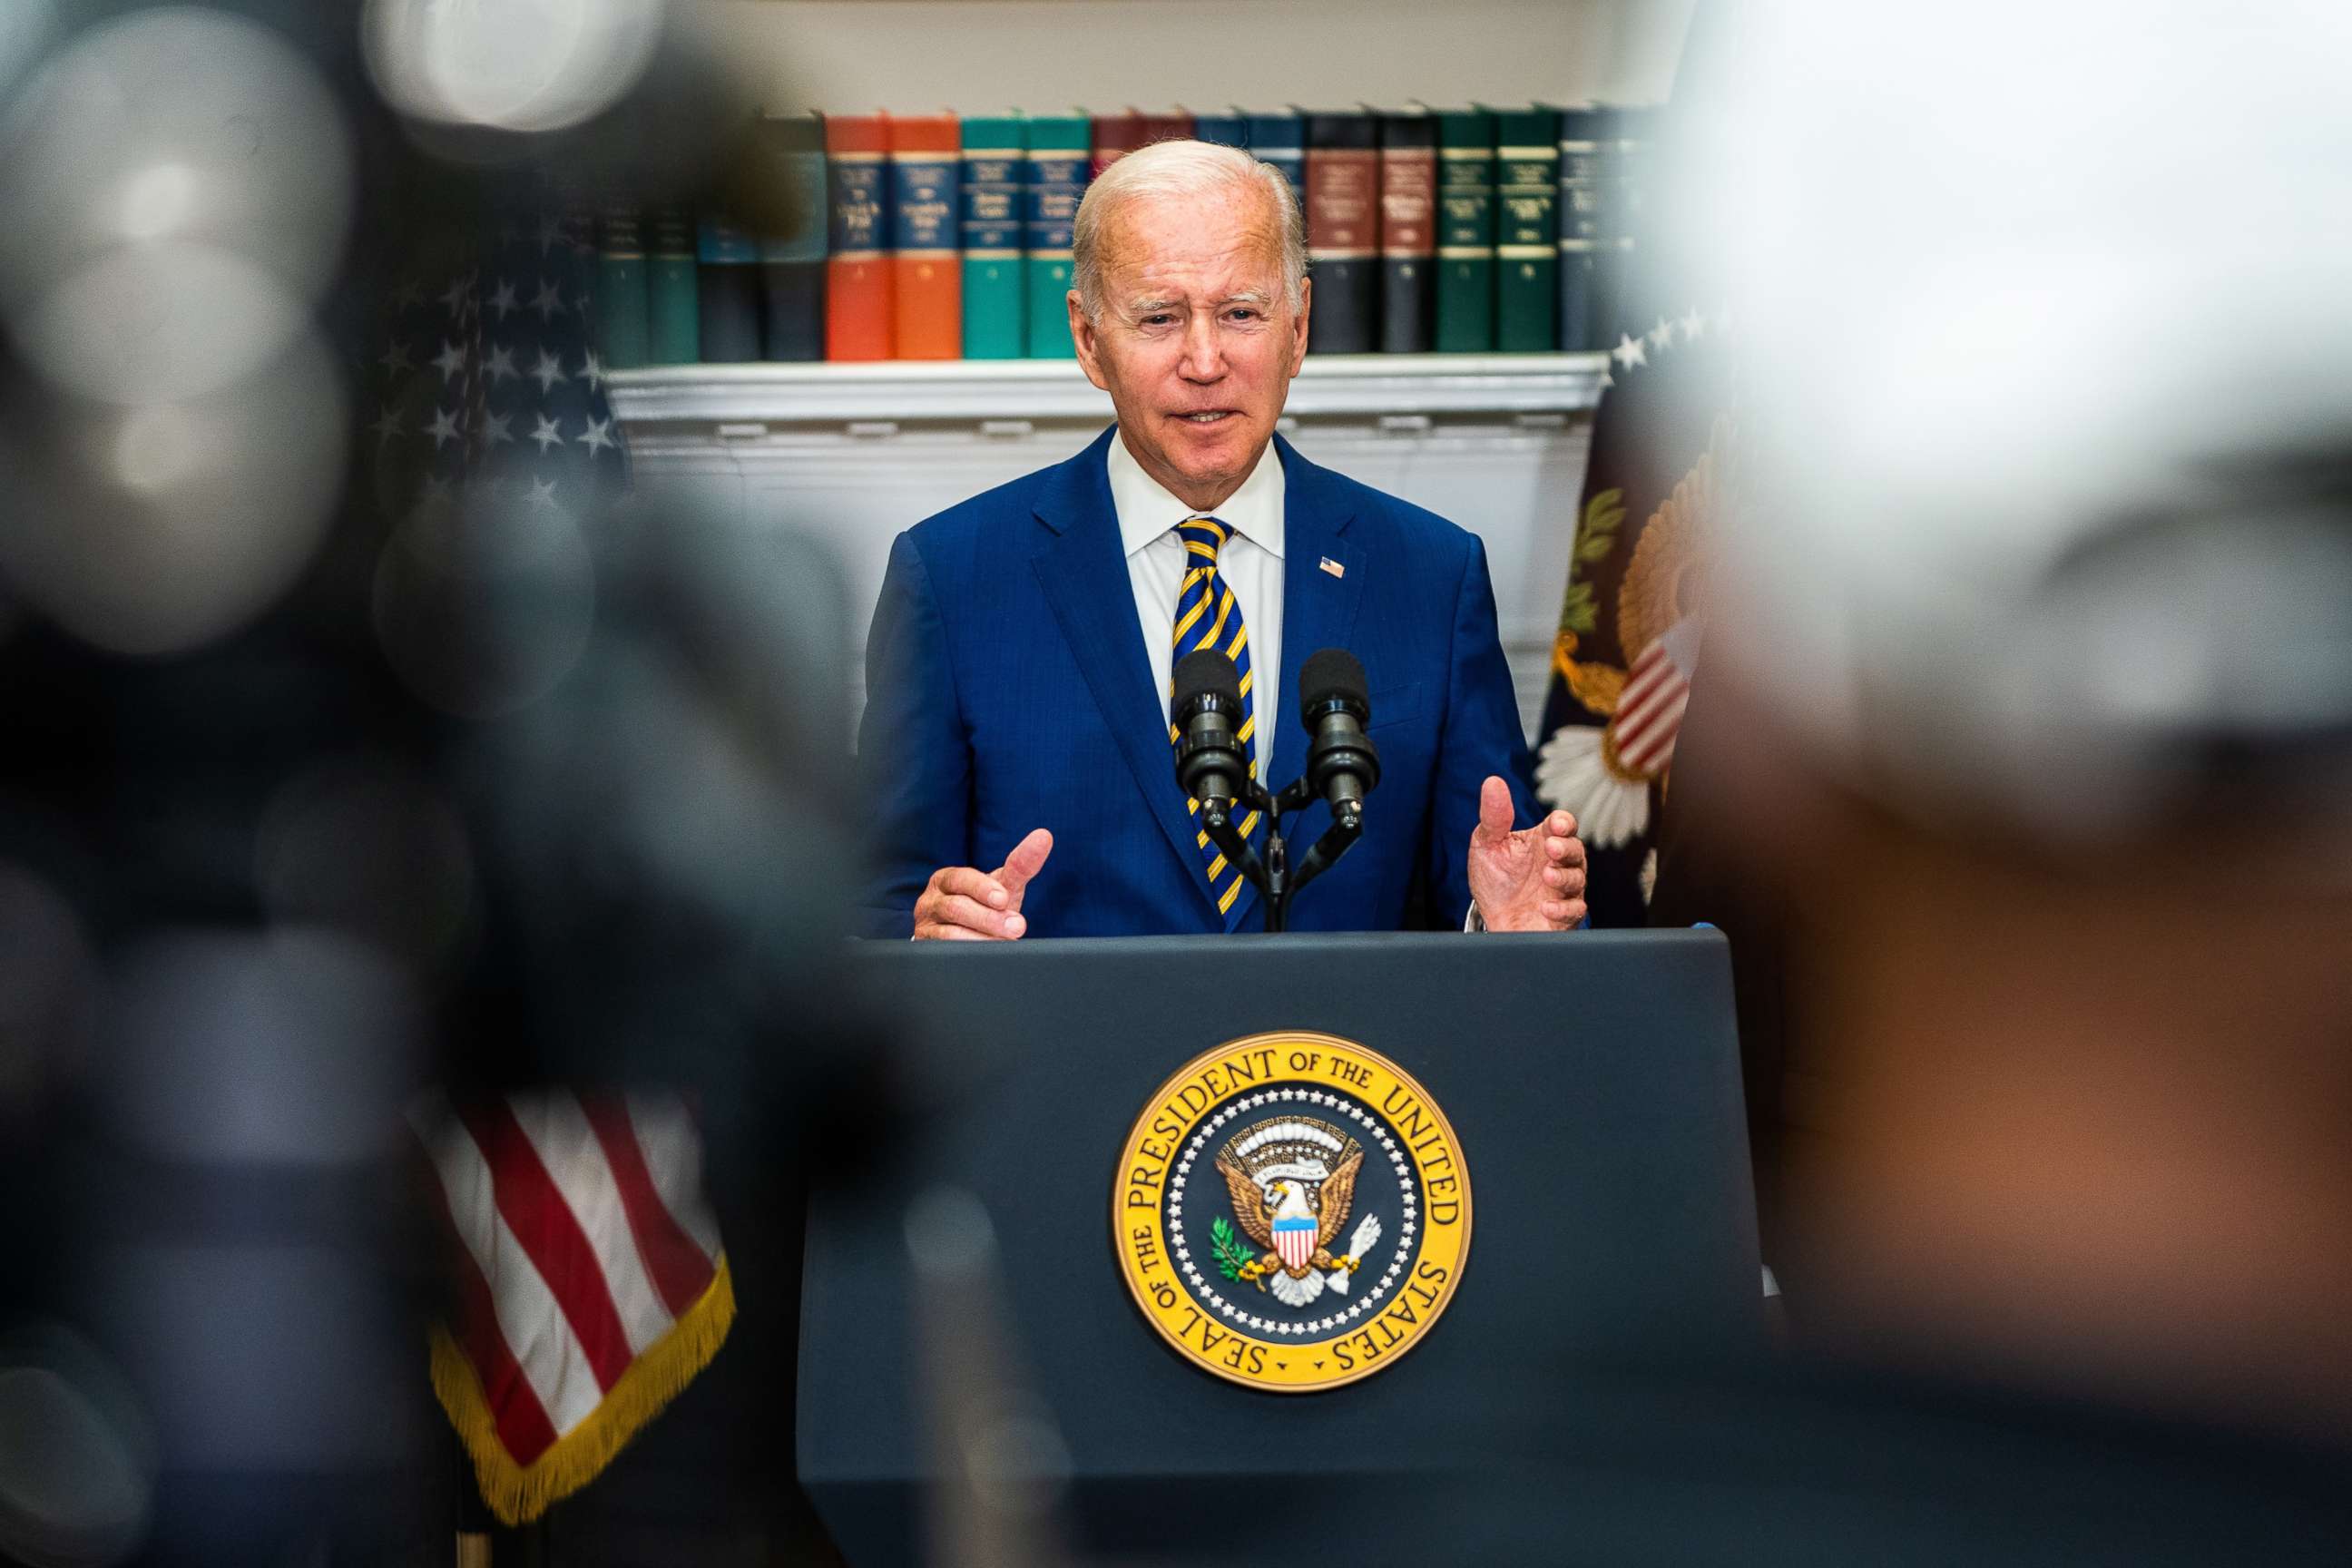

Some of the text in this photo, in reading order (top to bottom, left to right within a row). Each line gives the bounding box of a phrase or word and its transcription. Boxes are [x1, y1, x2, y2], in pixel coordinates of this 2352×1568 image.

[1128, 1049, 1459, 1374] SEAL OF THE PRESIDENT OF THE UNITED STATES
